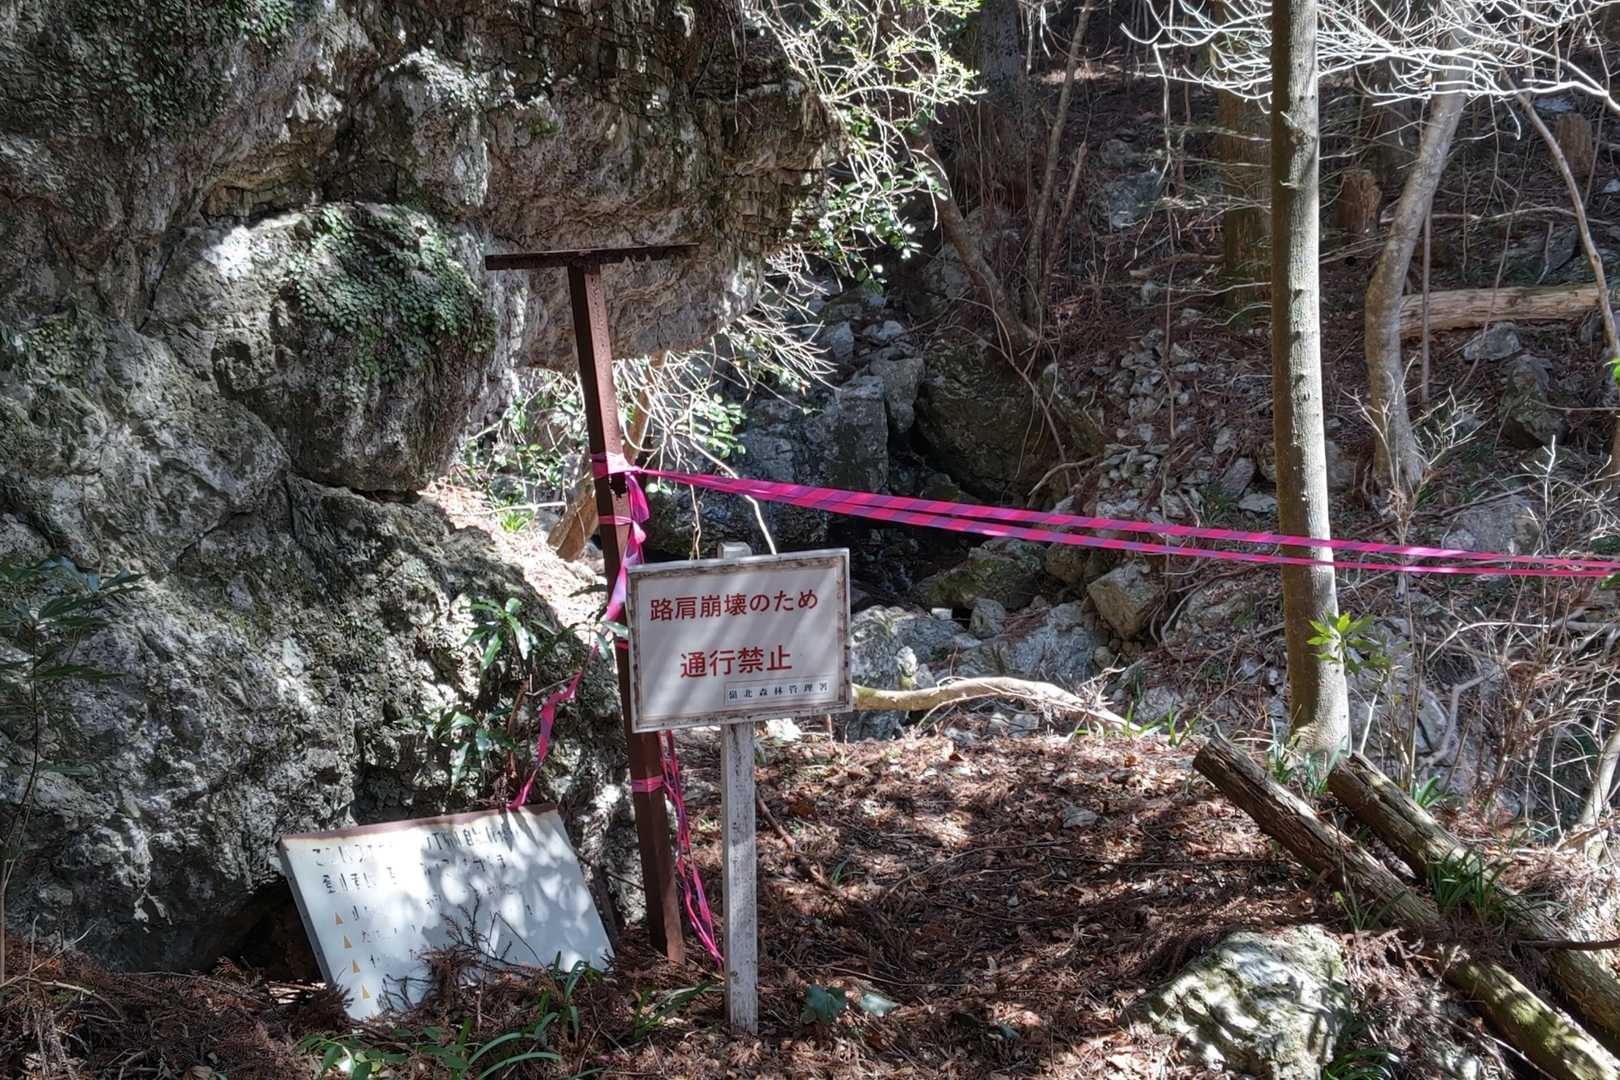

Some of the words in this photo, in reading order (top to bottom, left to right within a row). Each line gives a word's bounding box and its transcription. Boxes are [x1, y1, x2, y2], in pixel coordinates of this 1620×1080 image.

[650, 589, 818, 621] 路肩崩壊のため
[680, 645, 792, 679] 通行禁止
